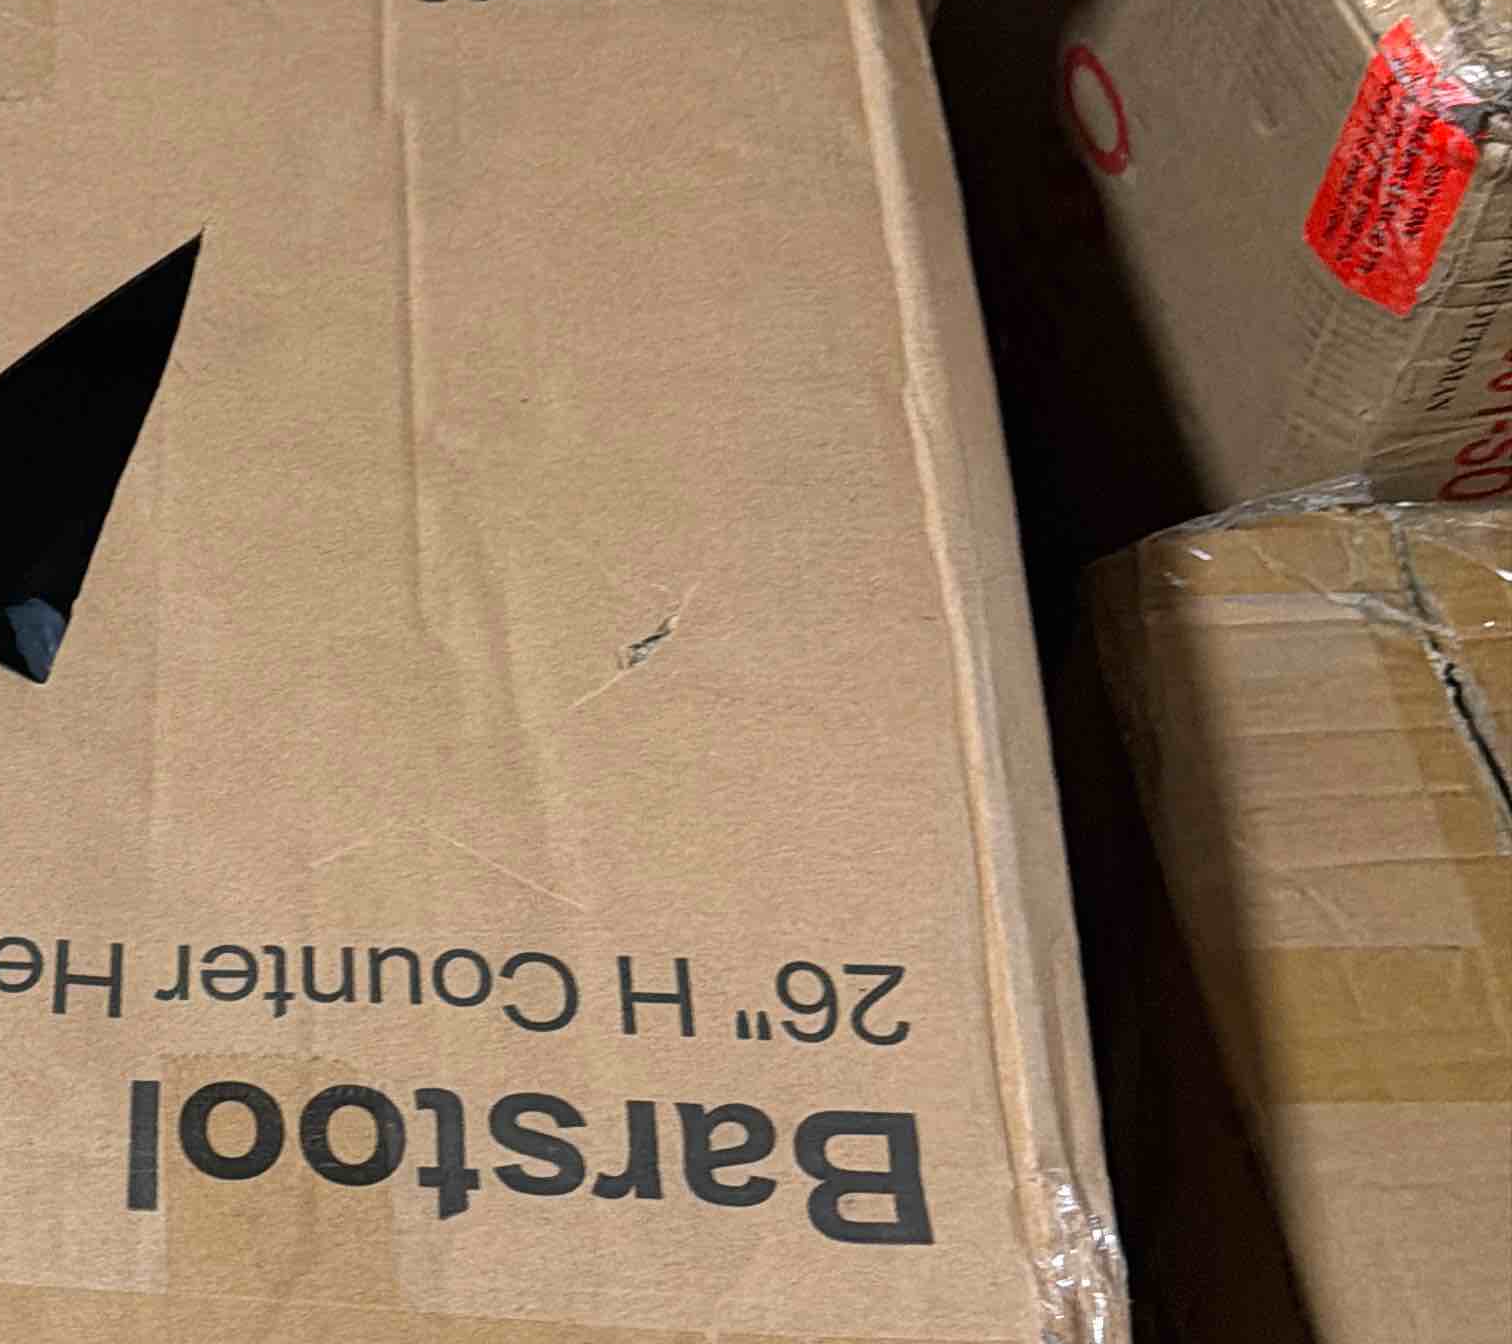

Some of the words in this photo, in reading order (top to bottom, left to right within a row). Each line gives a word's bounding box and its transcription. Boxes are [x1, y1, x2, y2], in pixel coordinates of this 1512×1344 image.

[156, 943, 579, 1032] Counter
[617, 955, 696, 1037] H
[737, 960, 909, 1044] 26"
[126, 1079, 934, 1245] Barstool
